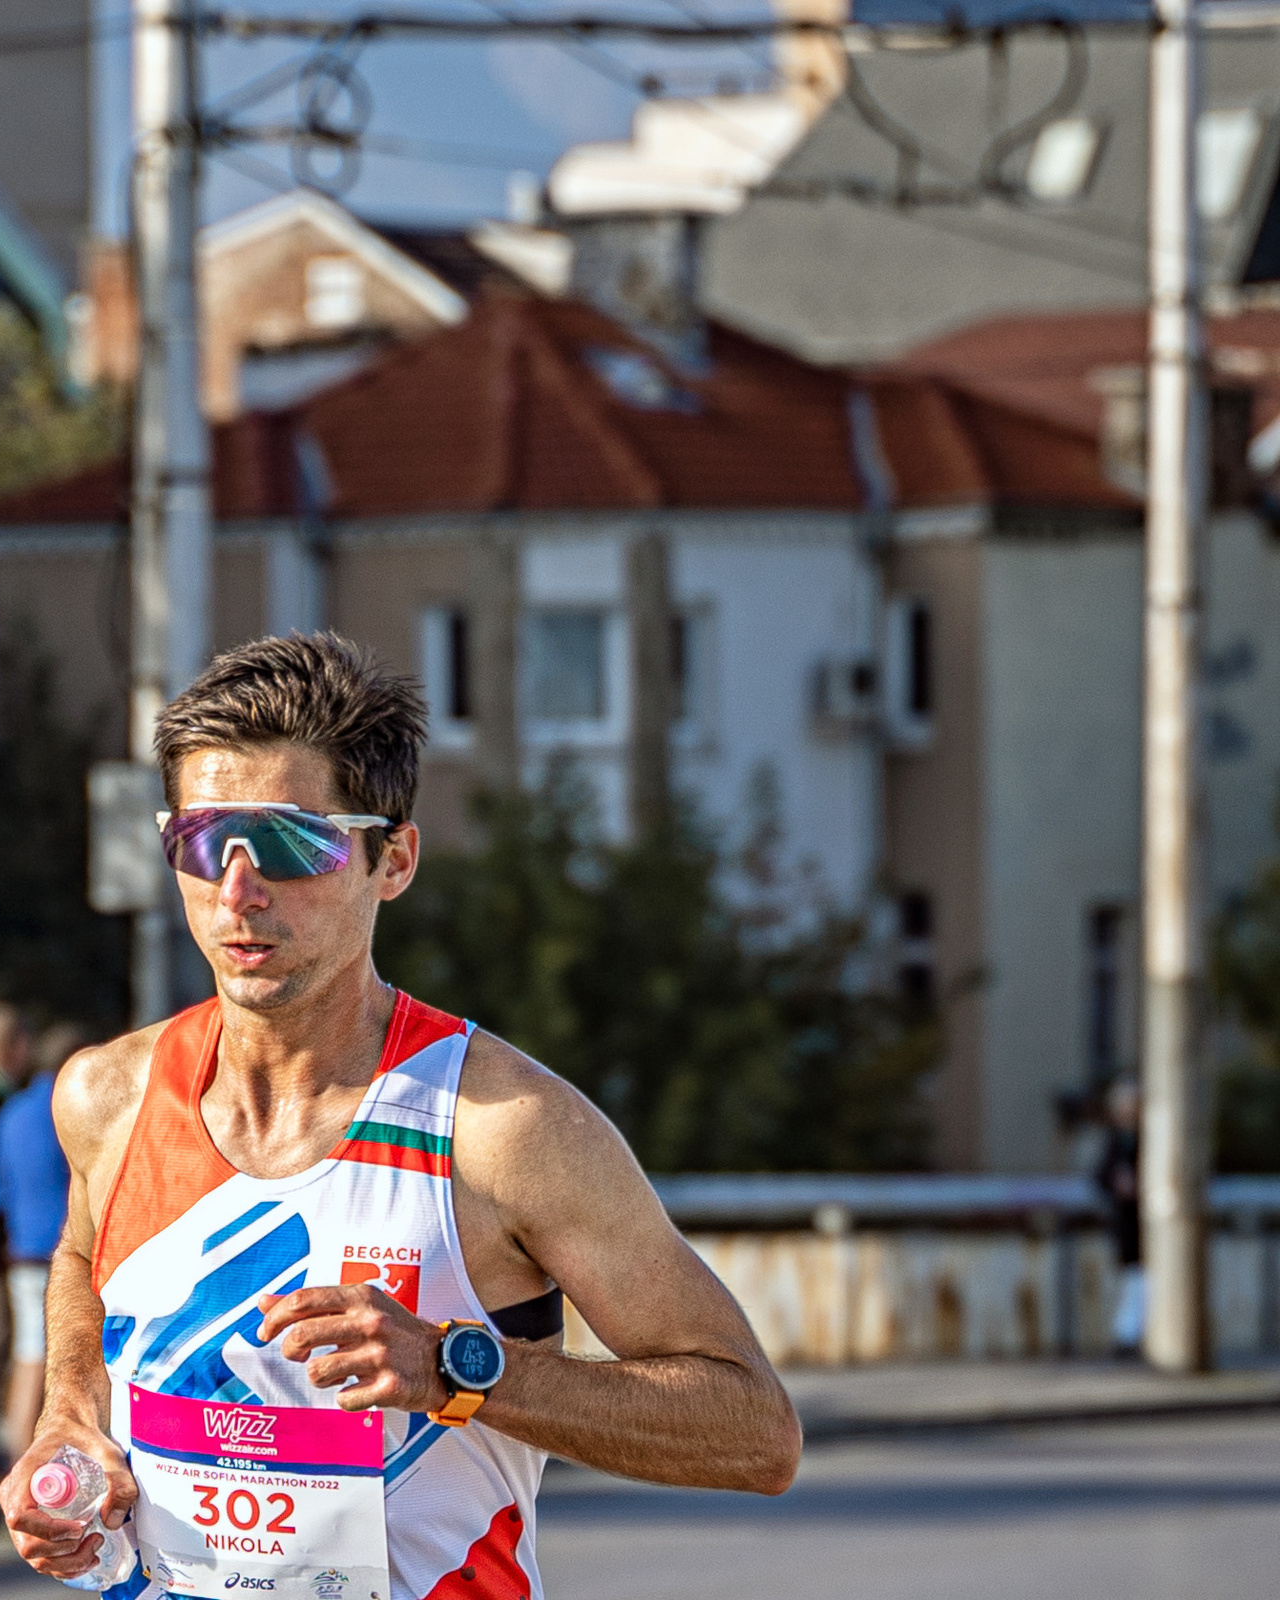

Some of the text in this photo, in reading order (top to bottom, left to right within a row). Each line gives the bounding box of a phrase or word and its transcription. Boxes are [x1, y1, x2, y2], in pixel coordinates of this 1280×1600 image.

[343, 1245, 422, 1262] BEGACH
[220, 1442, 278, 1456] wizzair.com
[216, 1457, 267, 1471] 42.195 km
[156, 1463, 340, 1490] WIZZ AIR SOFIA MARATHON 2022
[192, 1484, 296, 1534] 302
[205, 1533, 285, 1556] NIKOLA
